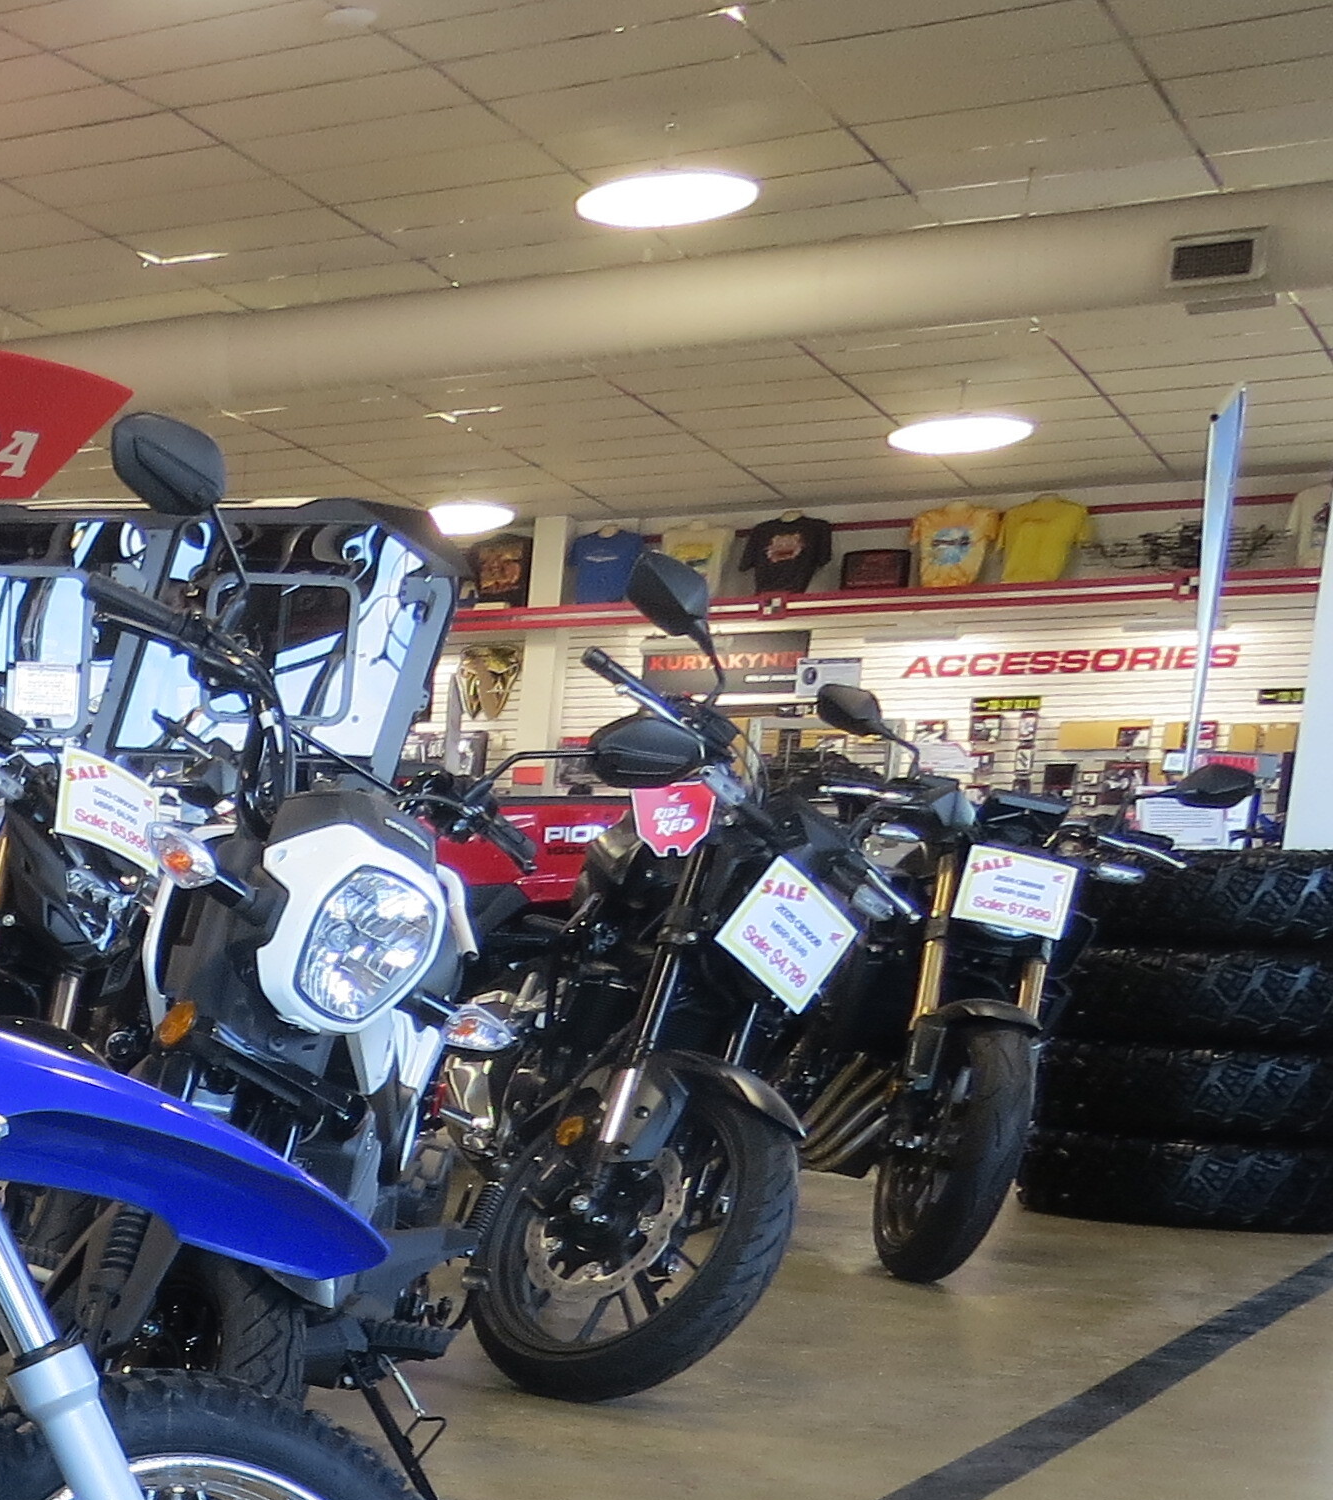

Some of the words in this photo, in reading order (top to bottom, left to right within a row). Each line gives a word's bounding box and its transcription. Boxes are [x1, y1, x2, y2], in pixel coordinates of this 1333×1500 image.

[900, 644, 1242, 679] ACCESSORIES
[65, 765, 108, 781] SALE
[652, 803, 688, 821] RIDE
[656, 817, 695, 838] RED
[970, 856, 1013, 873] SALE
[760, 879, 809, 902] SALE
